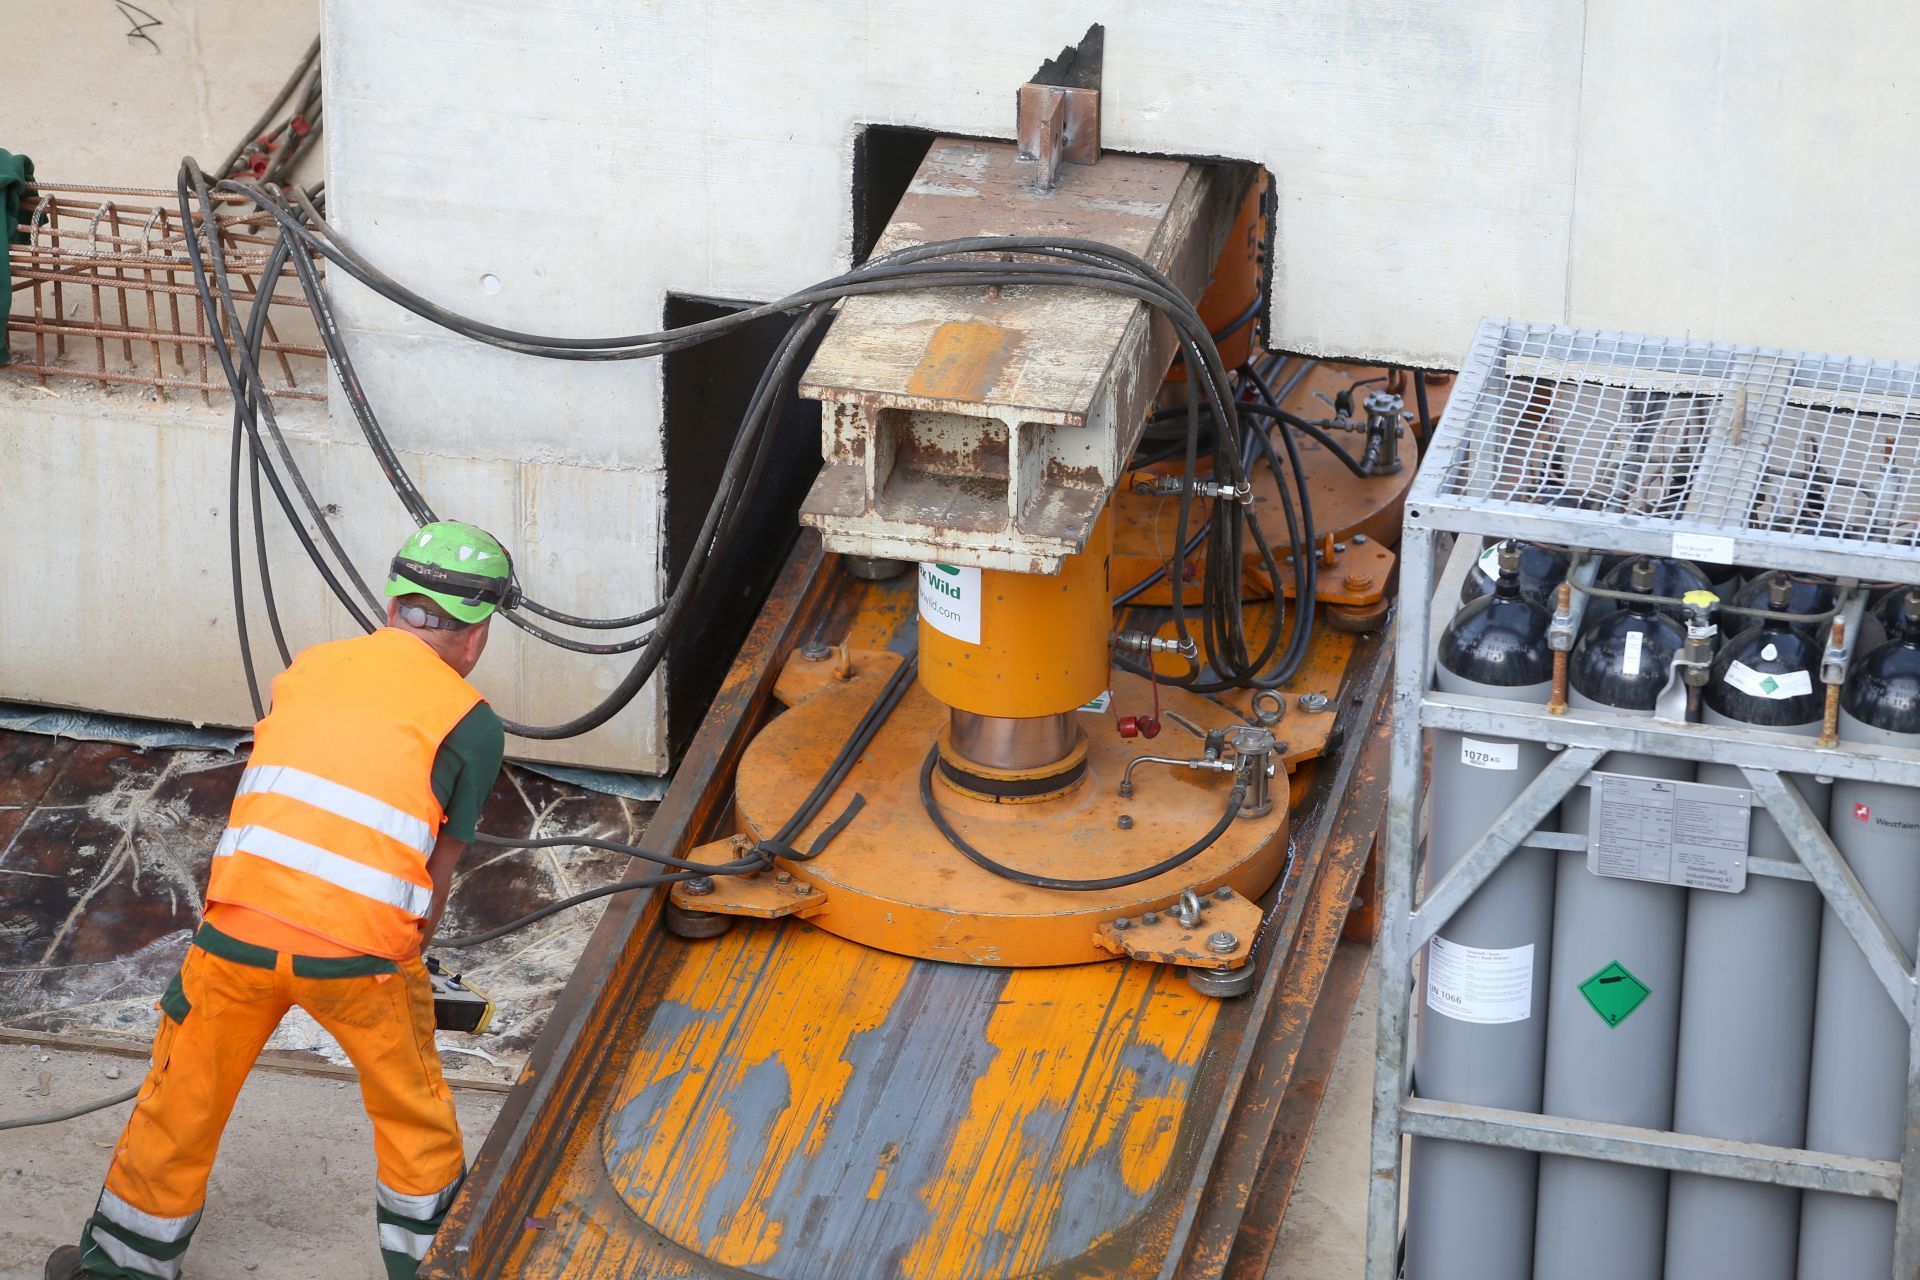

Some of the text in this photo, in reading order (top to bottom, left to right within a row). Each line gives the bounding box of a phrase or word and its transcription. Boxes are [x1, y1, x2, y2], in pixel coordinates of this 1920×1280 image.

[928, 571, 961, 600] Wild
[1464, 749, 1489, 762] 1078
[1875, 817, 1920, 829] Westfalen
[1429, 983, 1462, 1004] UN 1066
[1610, 1013, 1617, 1022] 2
